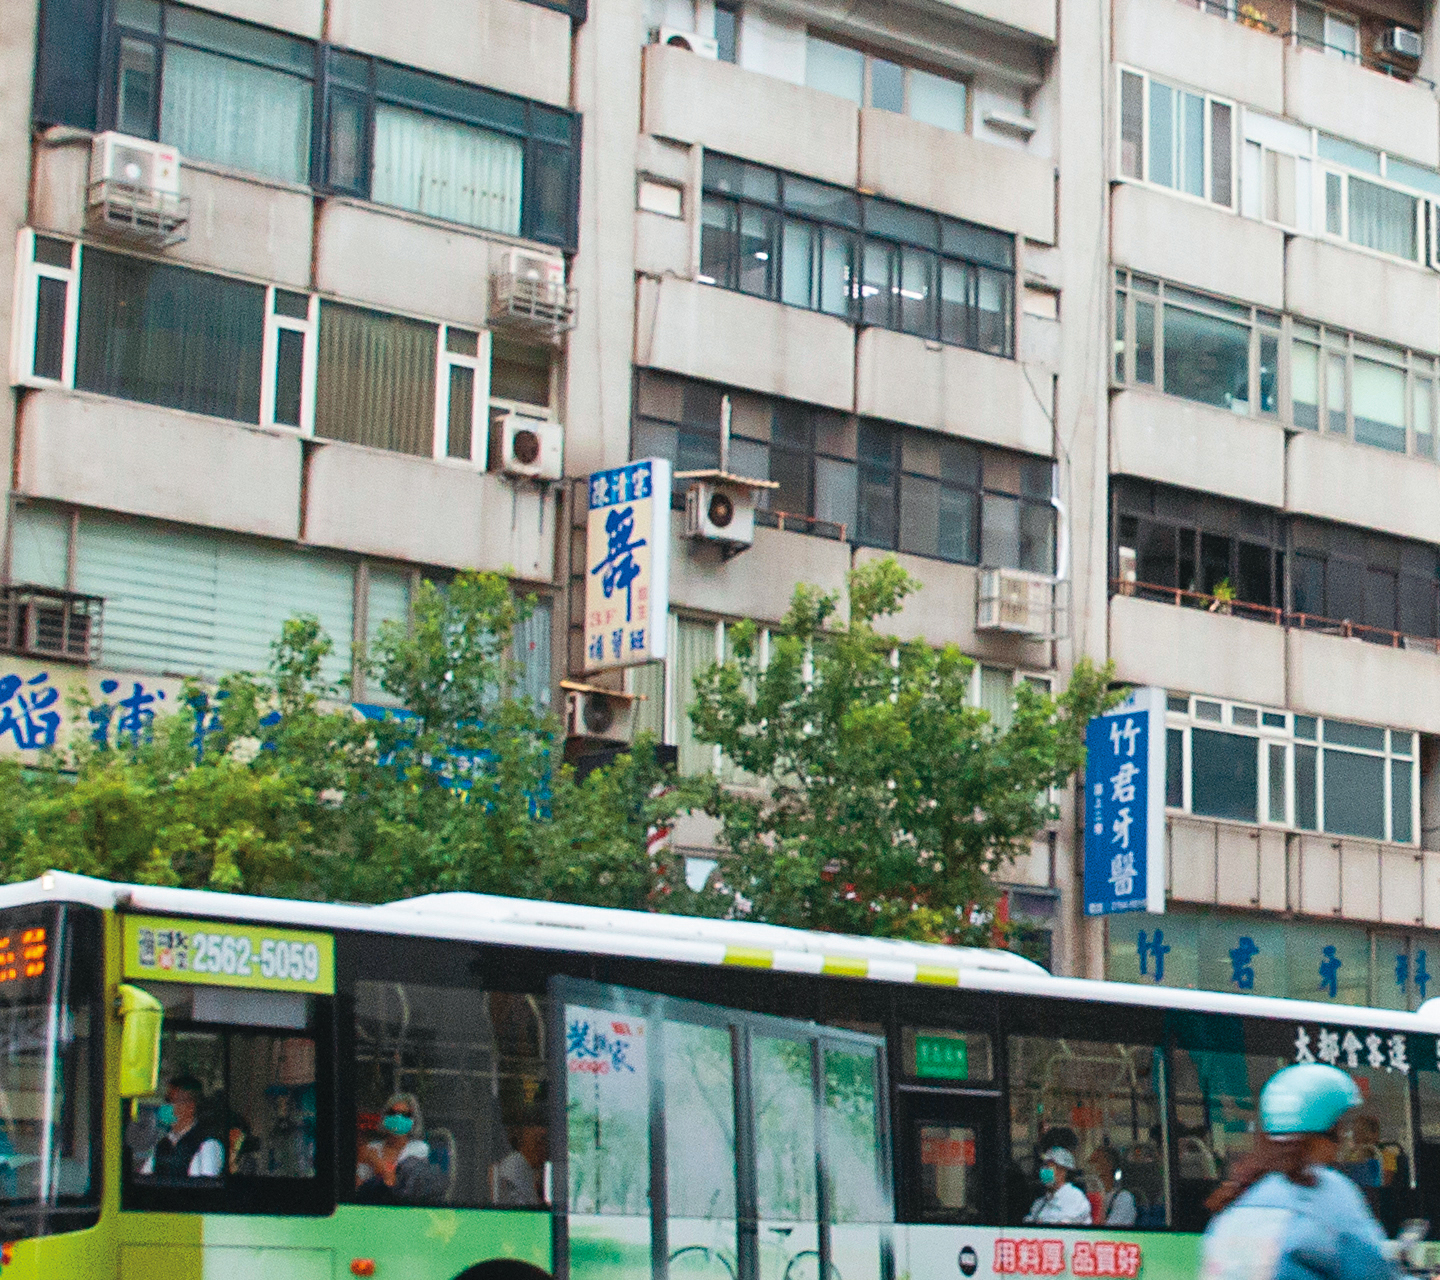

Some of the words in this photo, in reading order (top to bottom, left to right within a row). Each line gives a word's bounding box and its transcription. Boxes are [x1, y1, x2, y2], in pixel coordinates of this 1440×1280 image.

[1109, 718, 1141, 896] 竹君牙醫
[191, 931, 320, 983] 2562-5059
[1295, 1026, 1410, 1074] 大都會客運
